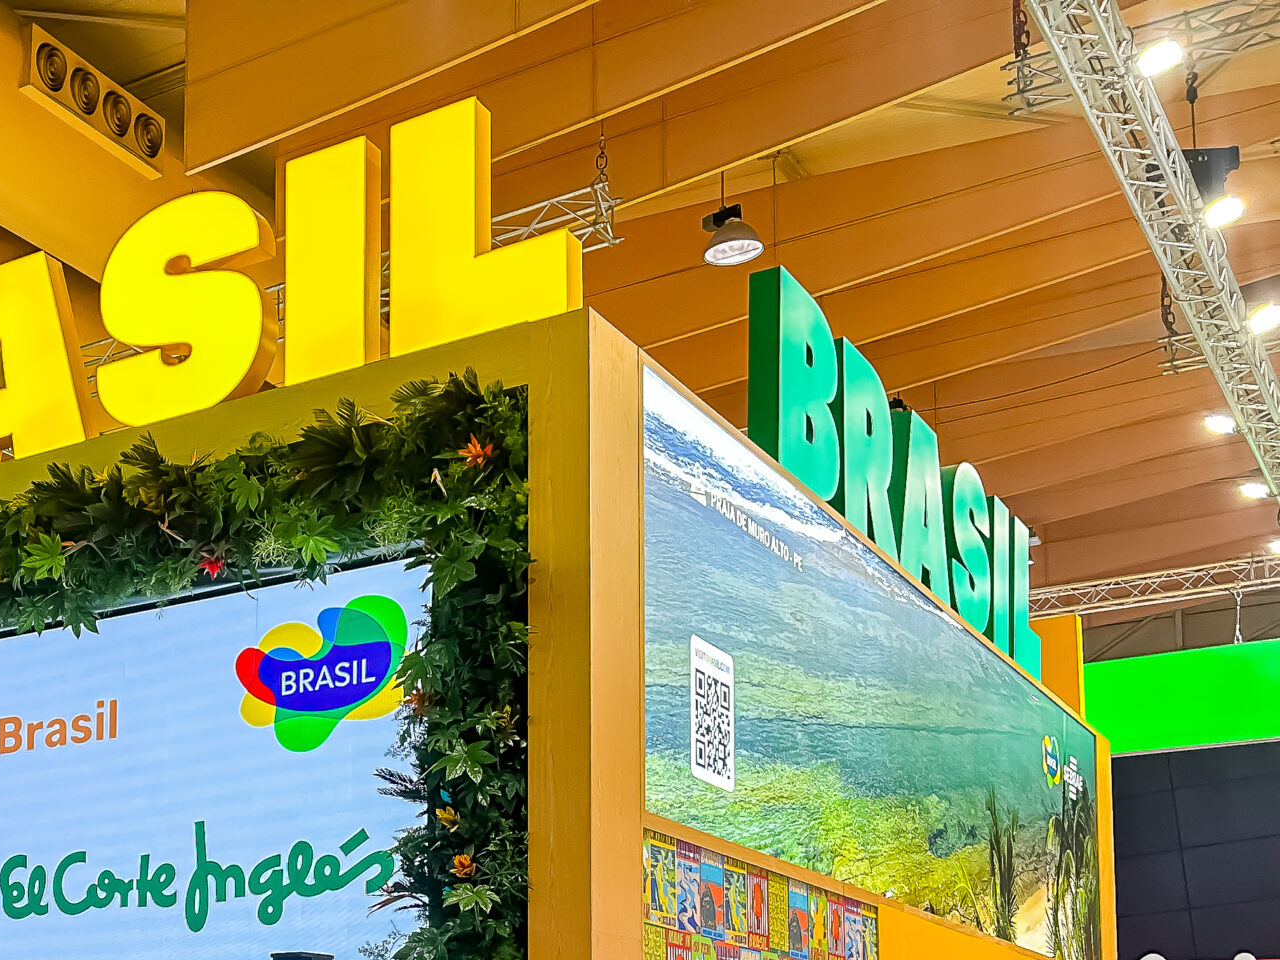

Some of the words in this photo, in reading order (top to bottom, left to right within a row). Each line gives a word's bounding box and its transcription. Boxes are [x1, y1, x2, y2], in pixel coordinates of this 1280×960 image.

[747, 263, 1043, 684] BRASIL
[710, 491, 737, 523] PRAIA
[736, 510, 749, 532] DE
[747, 519, 771, 548] MURO
[770, 535, 790, 563] ALTO
[793, 552, 803, 573] PE
[279, 655, 377, 697] BRASIL
[0, 854, 48, 922] El
[52, 850, 178, 912] Corte
